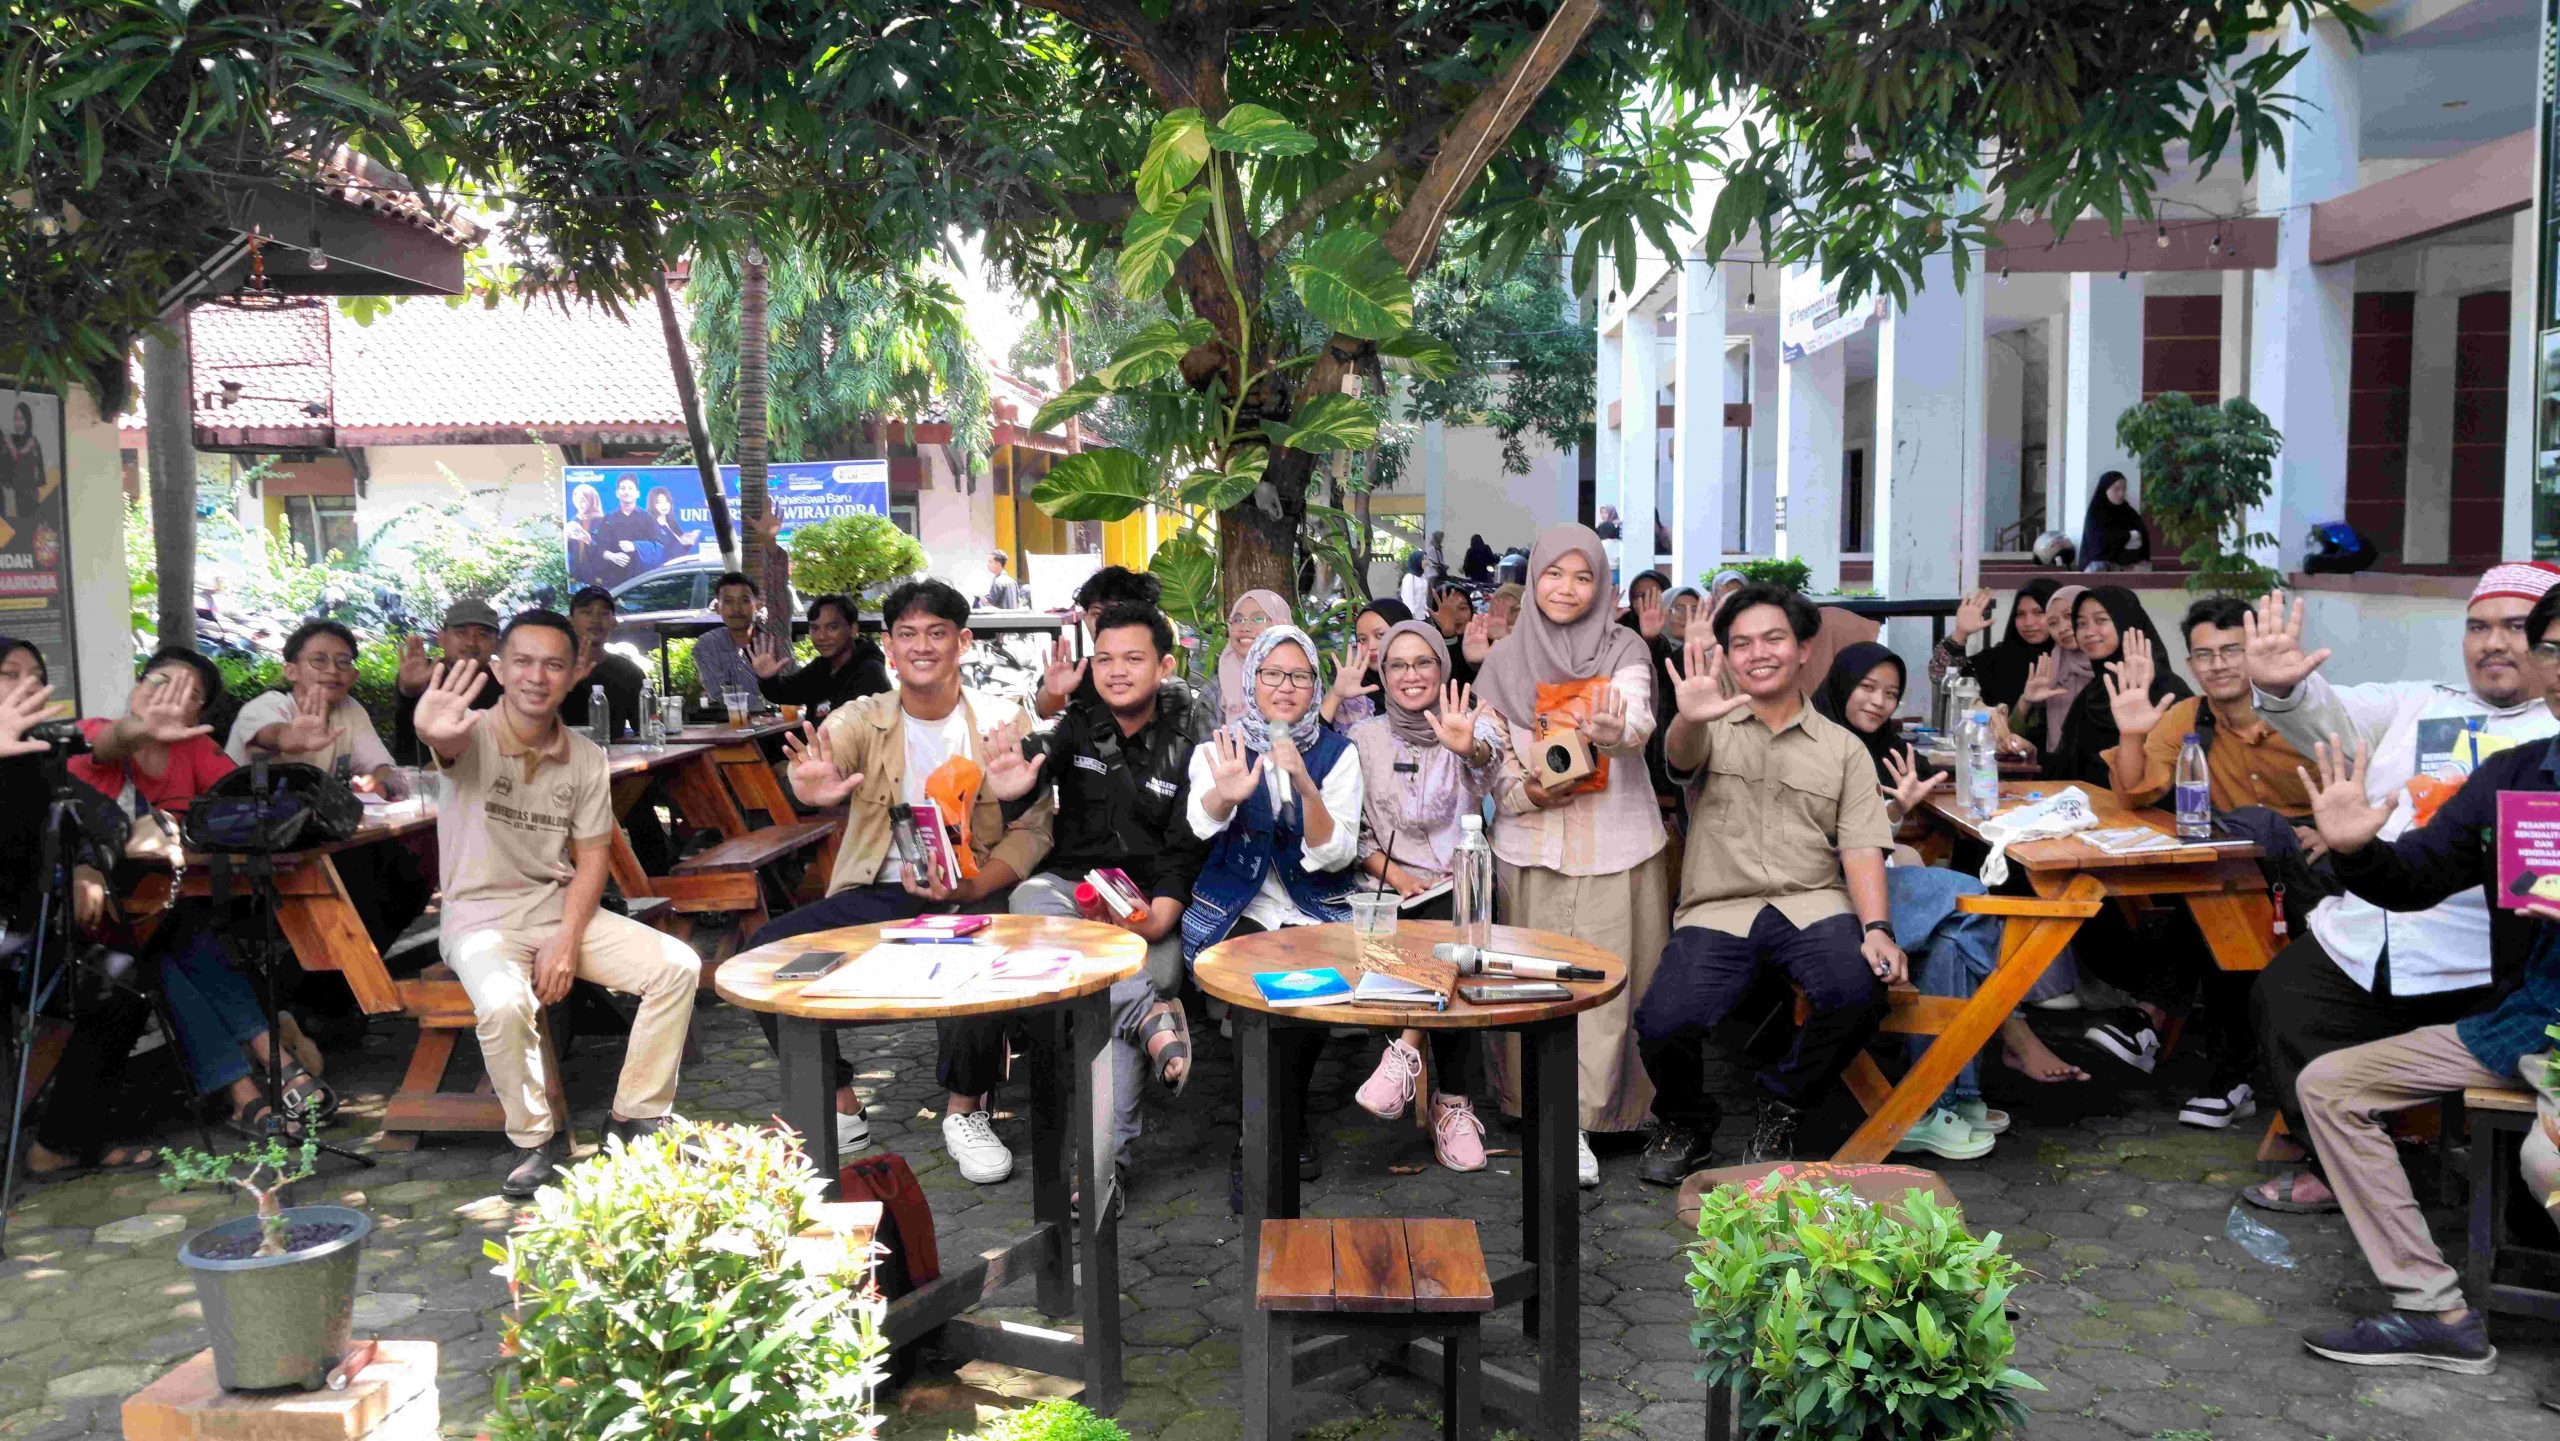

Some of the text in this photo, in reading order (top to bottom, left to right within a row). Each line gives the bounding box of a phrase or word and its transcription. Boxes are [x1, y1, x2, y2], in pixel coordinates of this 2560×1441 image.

[826, 493, 852, 504] Baru
[2514, 830, 2560, 839] SEKSUALIT
[2533, 840, 2554, 848] DAN
